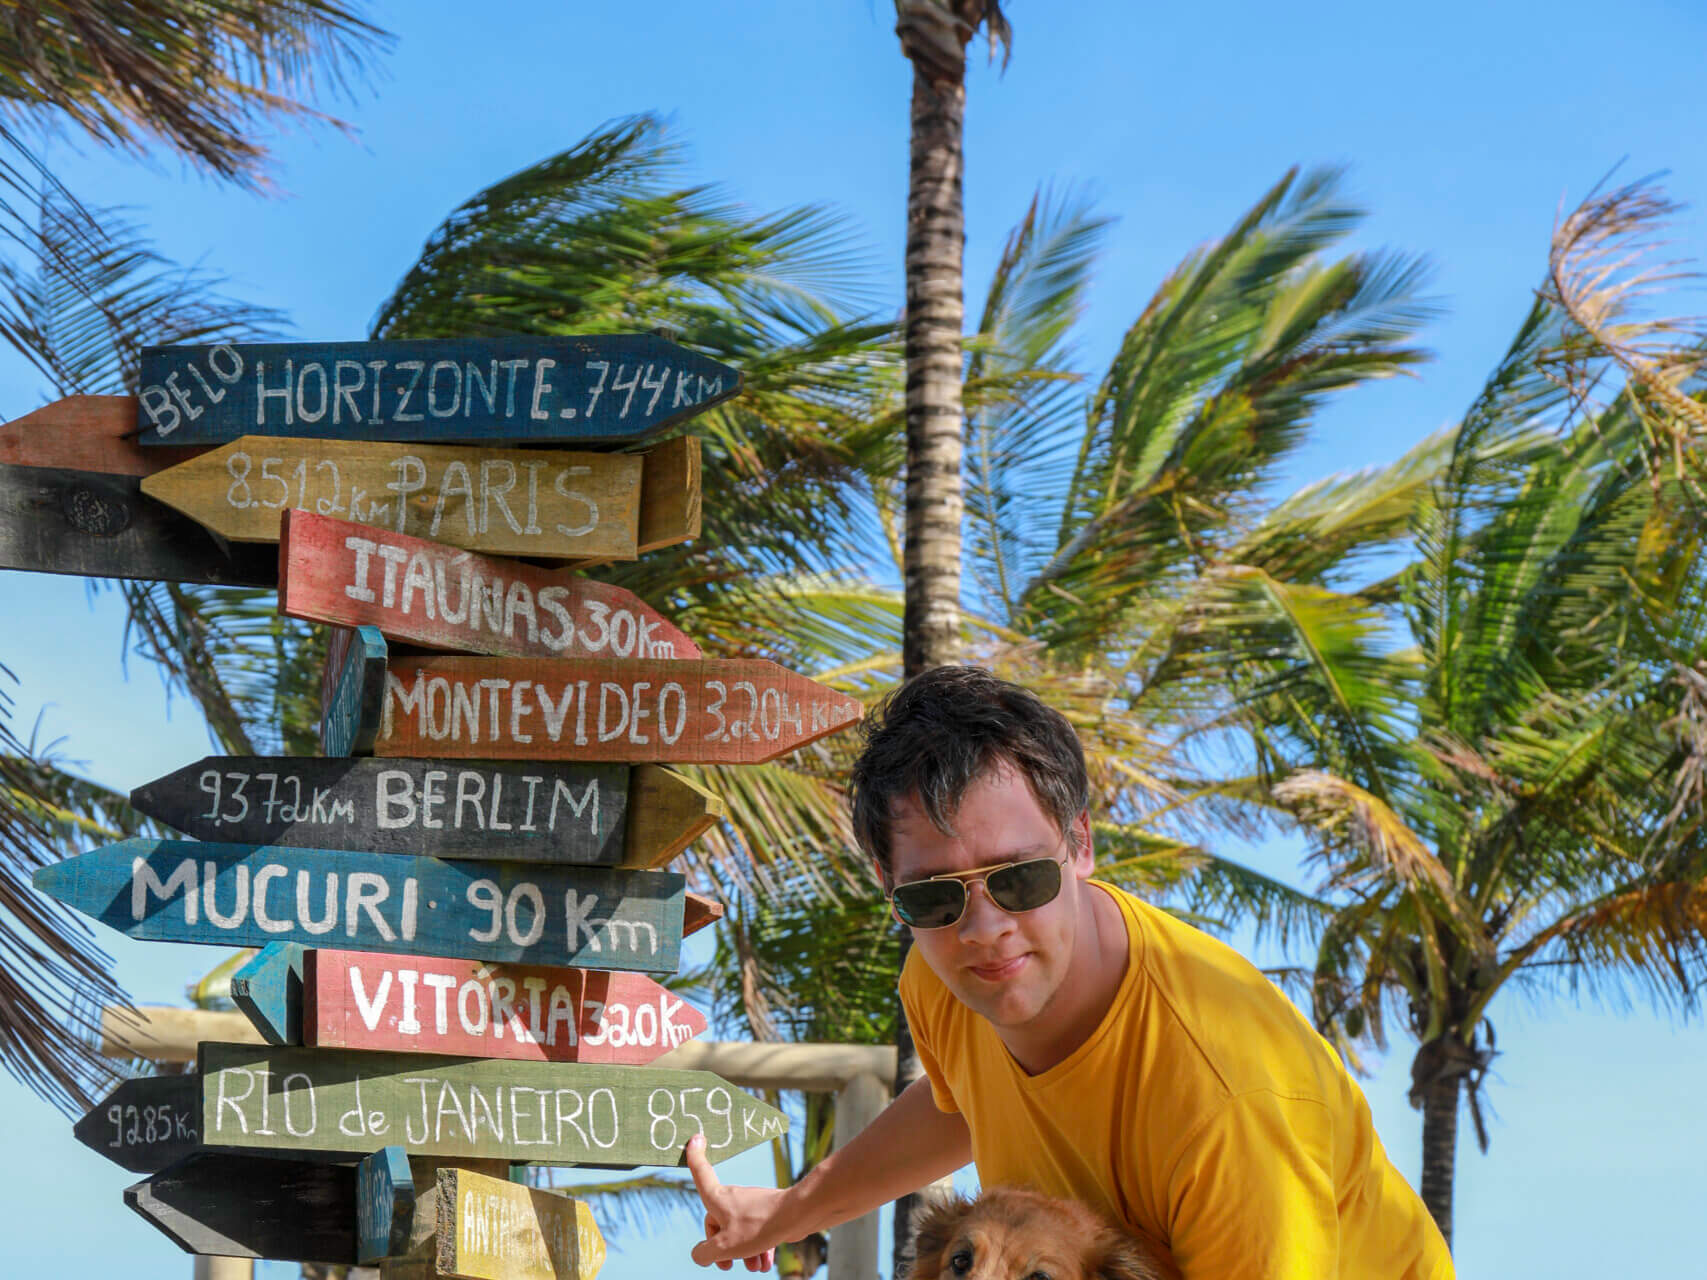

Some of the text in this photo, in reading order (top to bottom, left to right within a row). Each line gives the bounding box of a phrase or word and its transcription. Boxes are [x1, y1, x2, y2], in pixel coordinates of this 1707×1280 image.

[139, 344, 244, 438] BELO
[386, 455, 600, 538] PARIS
[344, 536, 576, 651] ITAÚNAS
[380, 671, 687, 745] MONTEVIDEO
[376, 770, 601, 835] BERLIM
[131, 856, 419, 942] MUCURI
[466, 878, 546, 947] 90
[349, 963, 578, 1047] VITÓRIA
[215, 1067, 318, 1138] RIO
[338, 1074, 390, 1137] de
[405, 1079, 619, 1150] JANEIRO
[647, 1086, 733, 1150] 859
